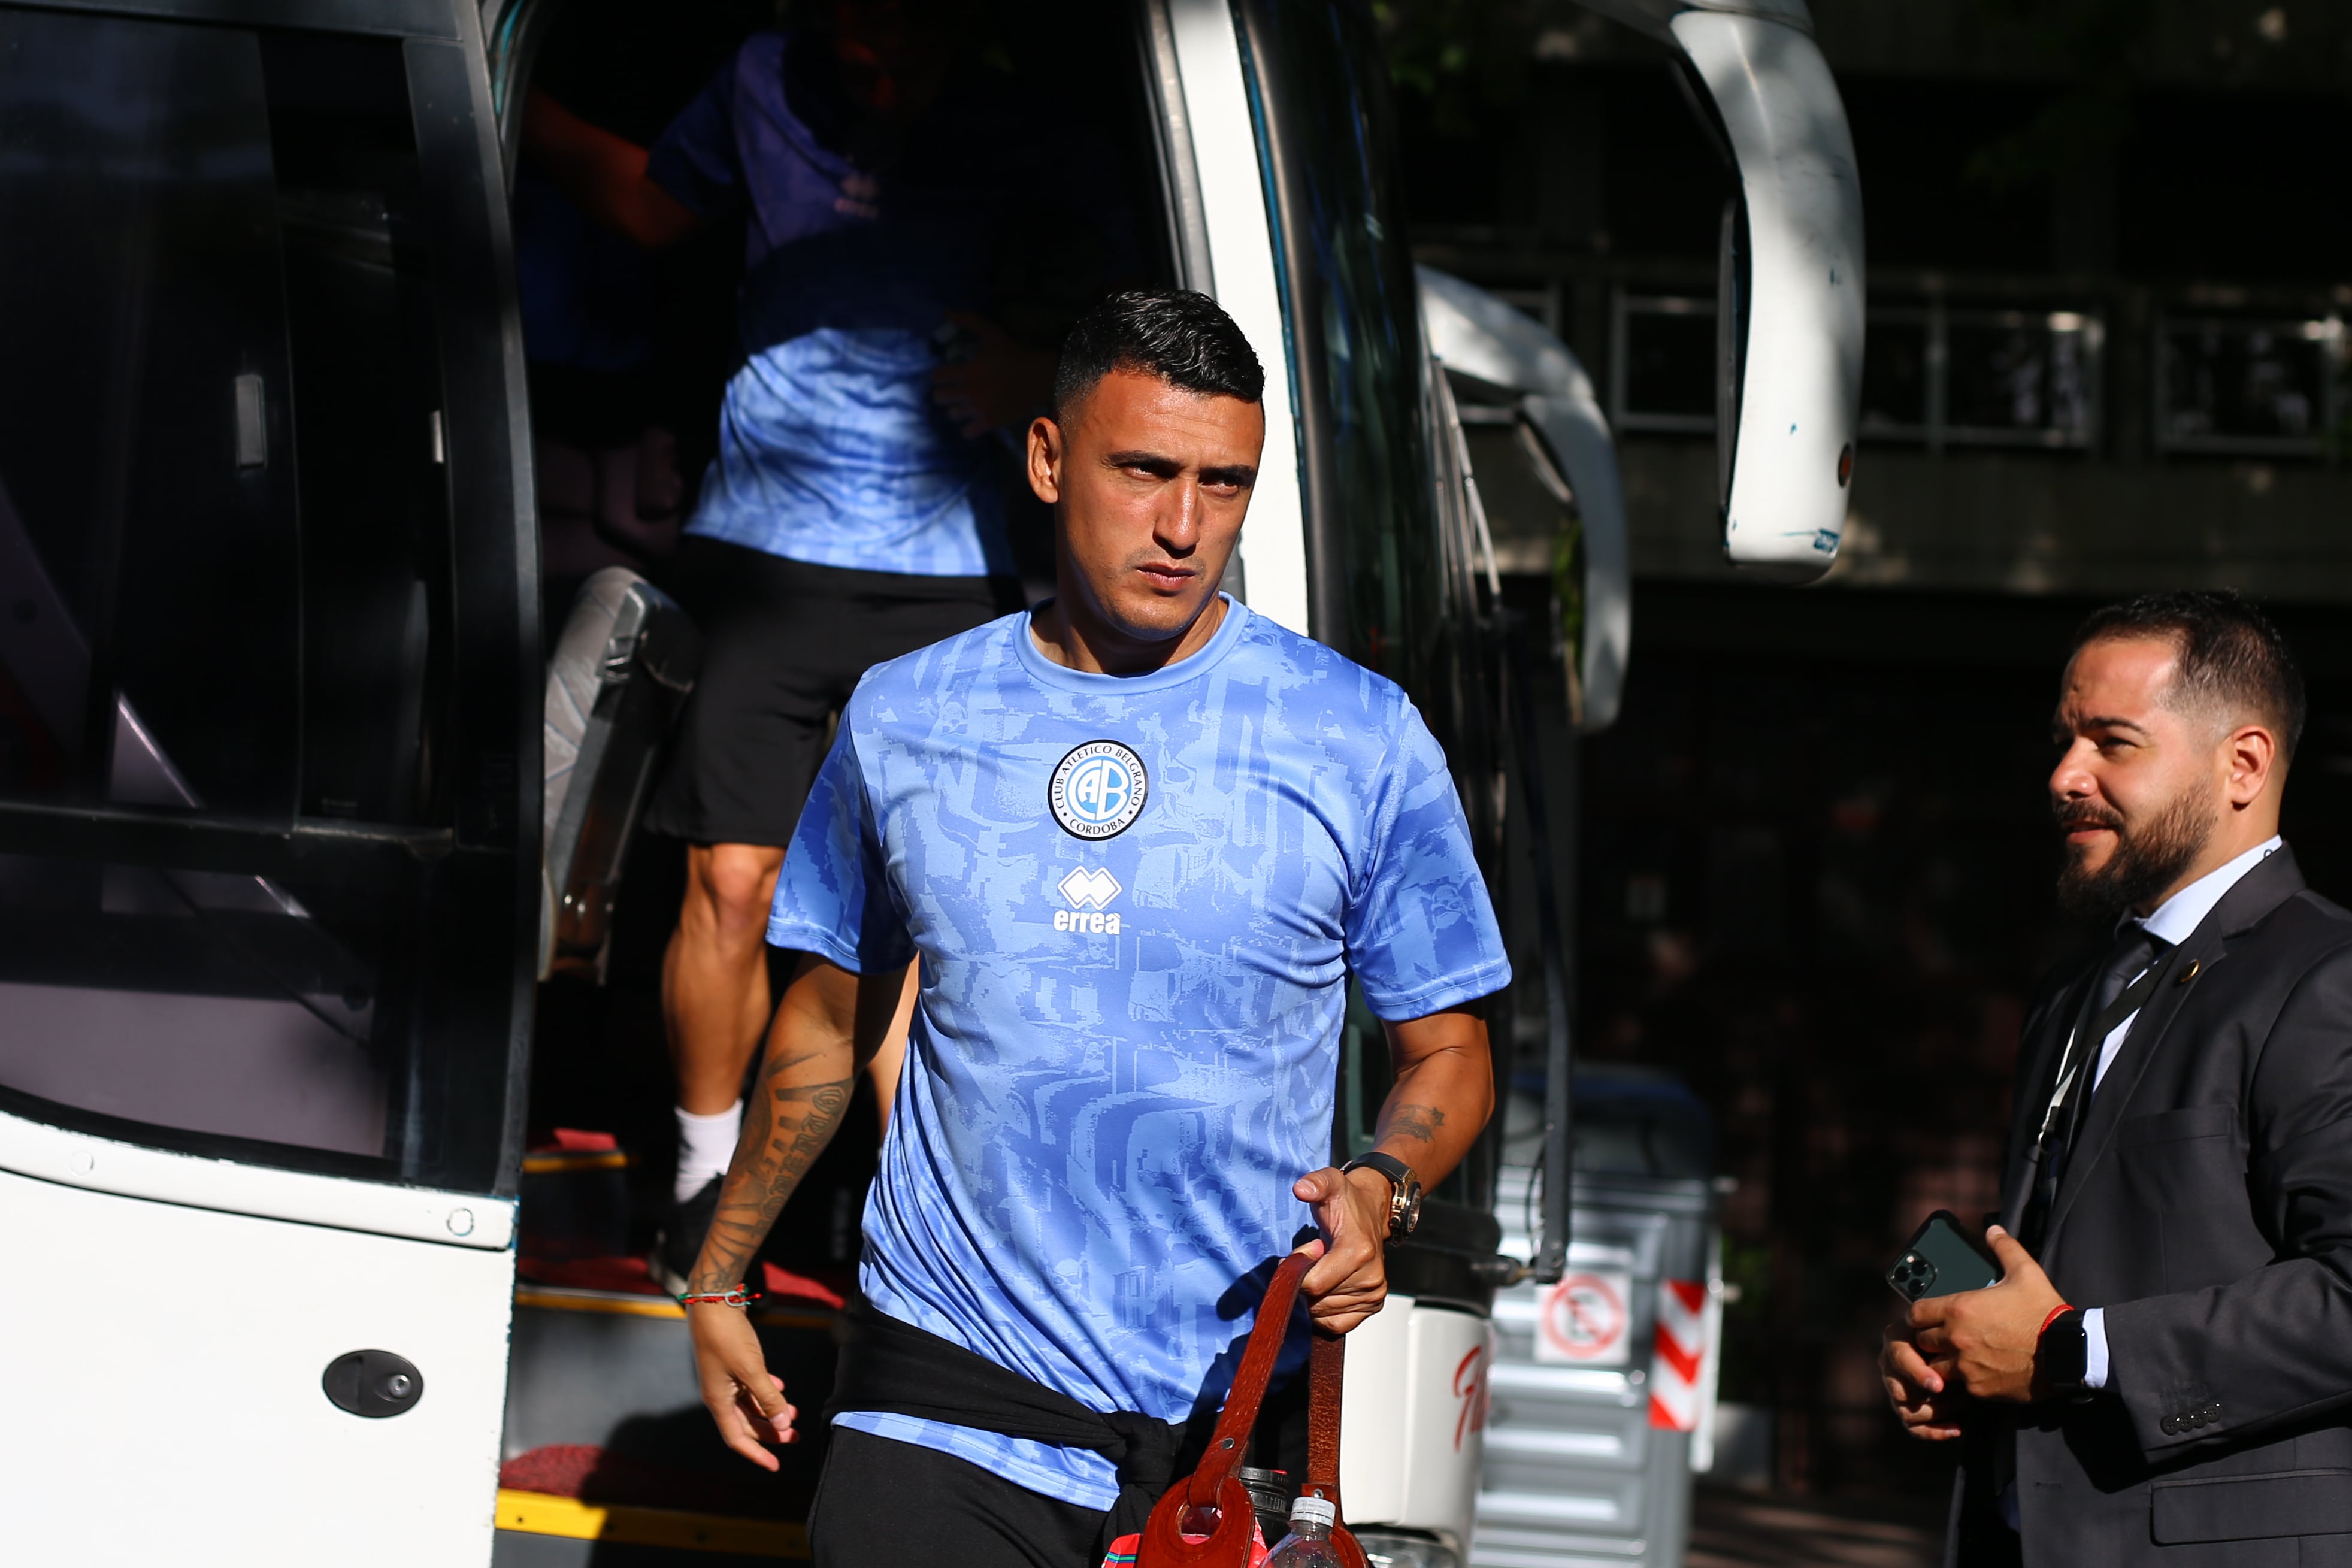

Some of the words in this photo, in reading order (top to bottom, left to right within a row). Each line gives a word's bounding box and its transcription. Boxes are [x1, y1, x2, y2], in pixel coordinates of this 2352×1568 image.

[1054, 778, 1065, 809] CLUB
[1062, 745, 1112, 774] ATLETICO
[1115, 748, 1143, 806] BELGRANO
[1070, 818, 1125, 834] CORDOBA
